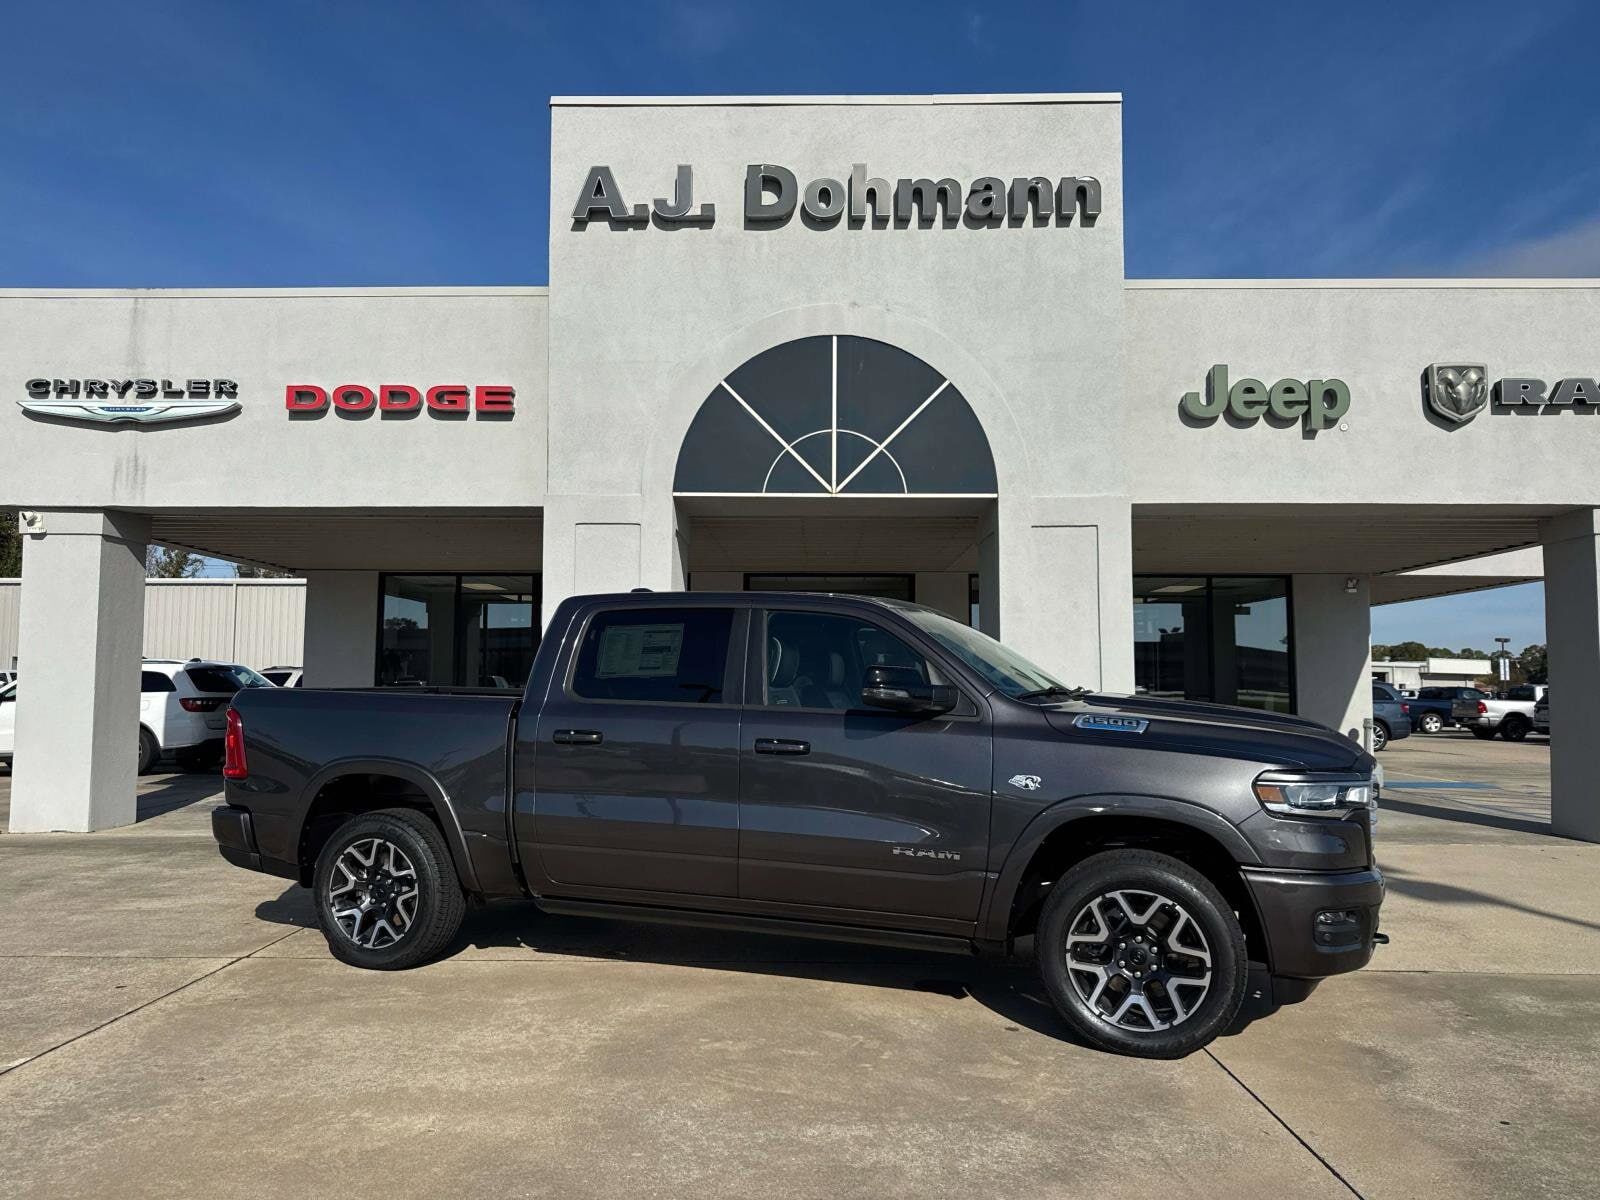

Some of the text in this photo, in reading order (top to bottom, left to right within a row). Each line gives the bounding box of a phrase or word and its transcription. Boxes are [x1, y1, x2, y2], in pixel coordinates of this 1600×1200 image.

[571, 163, 1102, 226] A.J. Dohmann
[25, 378, 239, 398] CHRYSLER
[285, 384, 515, 416] DODGE
[1181, 364, 1351, 432] Jeep
[1494, 377, 1600, 408] RA
[892, 846, 961, 861] RAM
